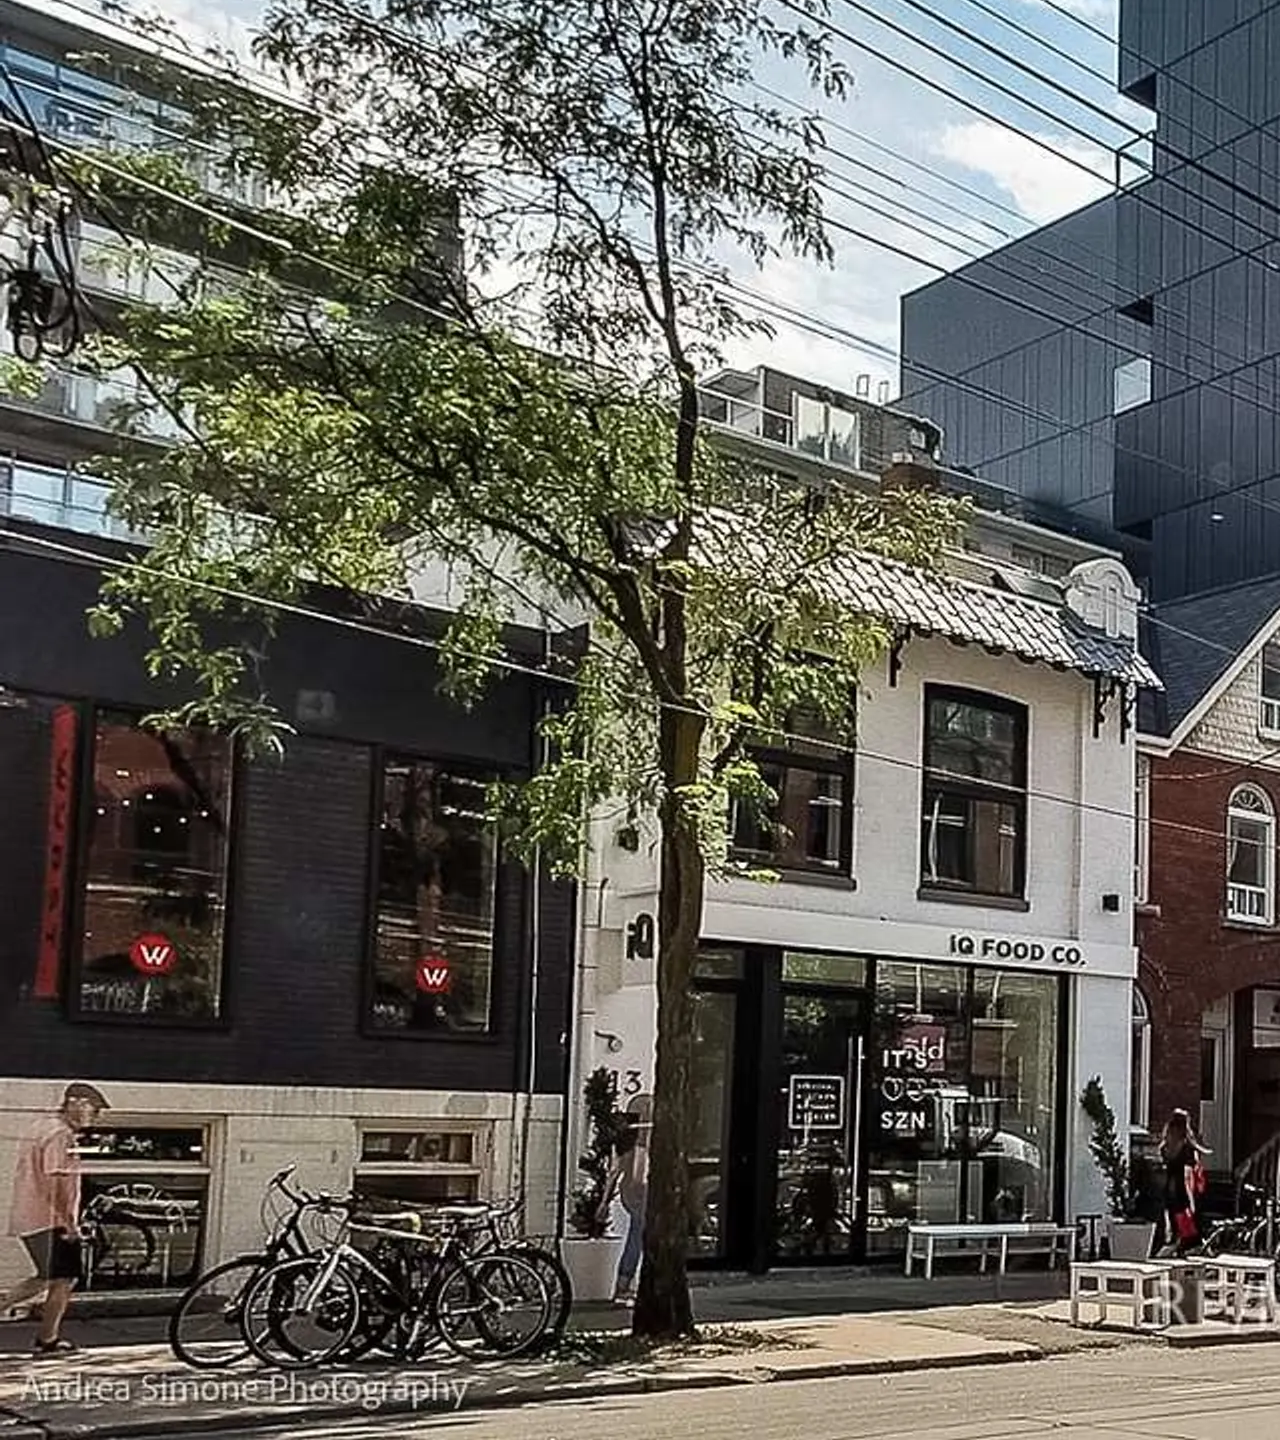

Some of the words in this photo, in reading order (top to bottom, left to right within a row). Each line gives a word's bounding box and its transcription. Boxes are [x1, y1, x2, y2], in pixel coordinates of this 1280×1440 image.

[140, 944, 170, 965] W
[982, 939, 1045, 961] FOOD
[1052, 946, 1087, 966] CO.
[423, 967, 447, 985] W
[884, 1049, 927, 1068] IT'S
